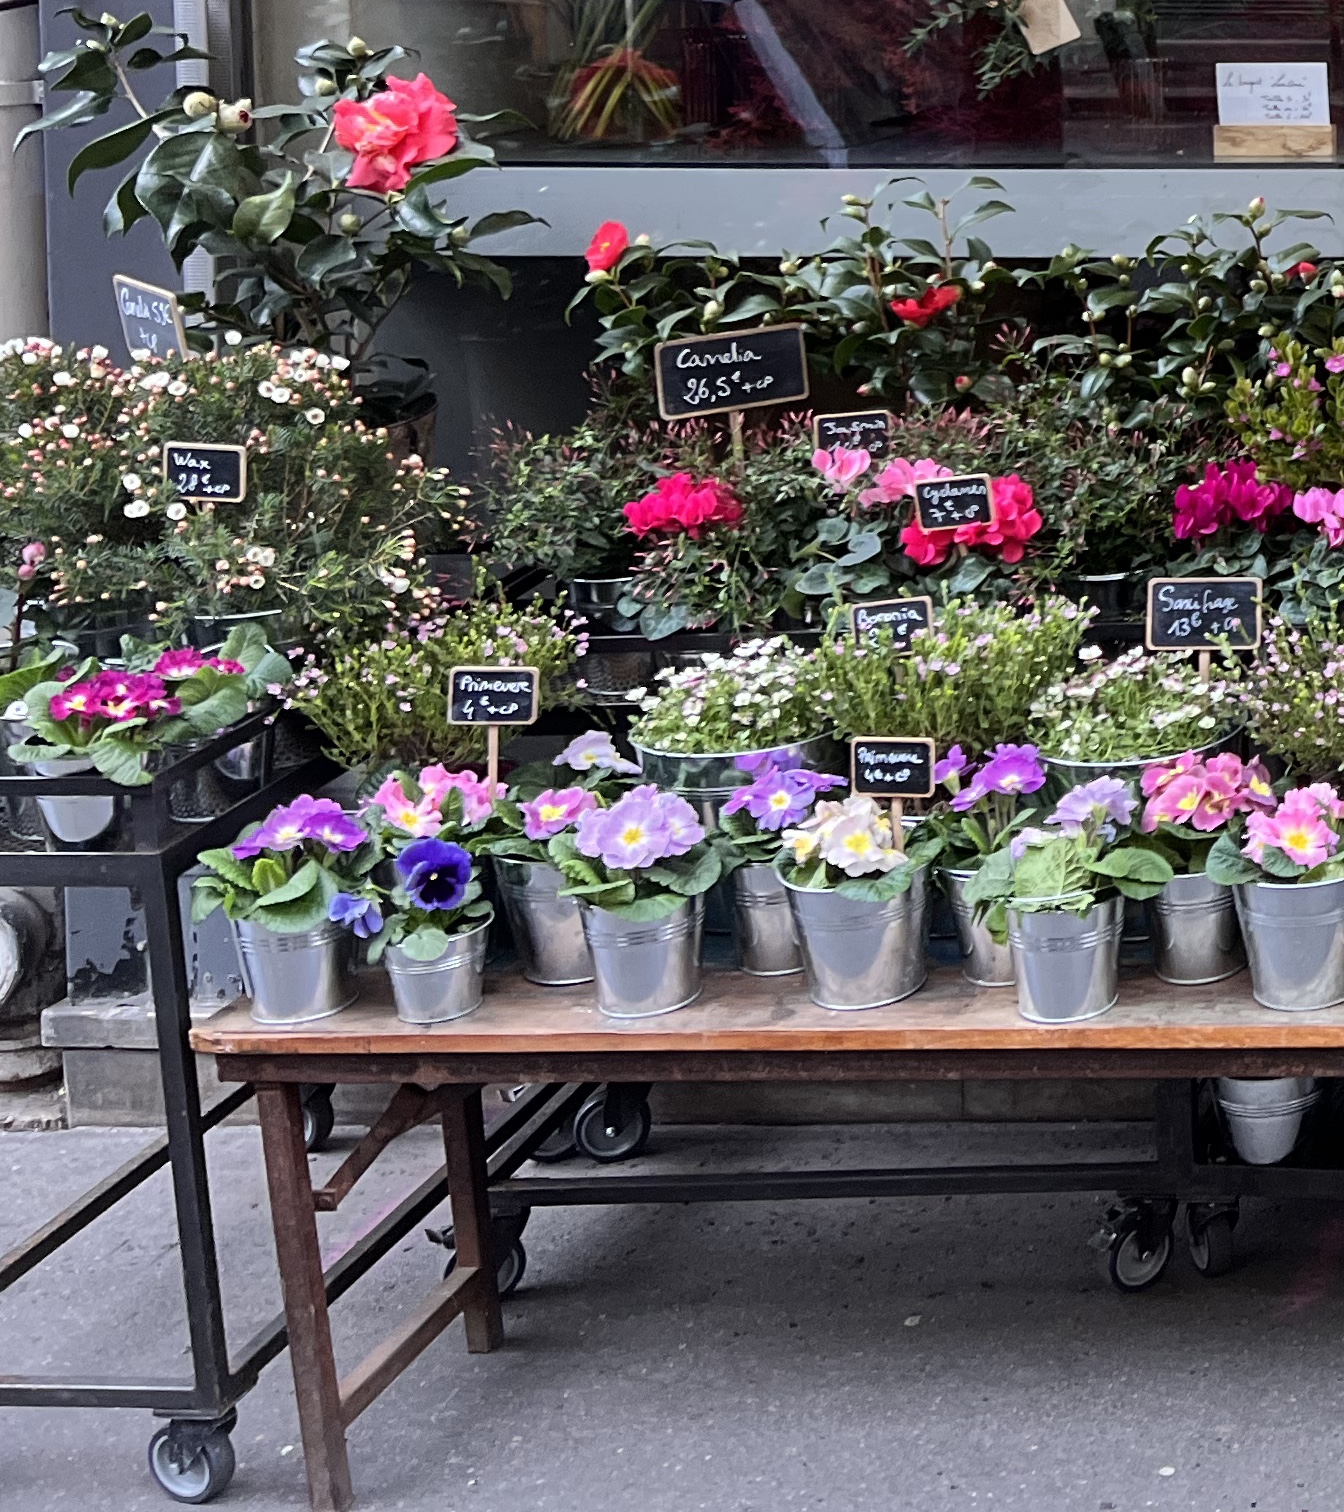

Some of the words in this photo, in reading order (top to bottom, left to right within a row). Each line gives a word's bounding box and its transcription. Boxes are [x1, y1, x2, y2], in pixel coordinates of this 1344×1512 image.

[172, 452, 212, 471] Wax
[177, 473, 211, 494] 28€
[1167, 611, 1203, 637] 13€
